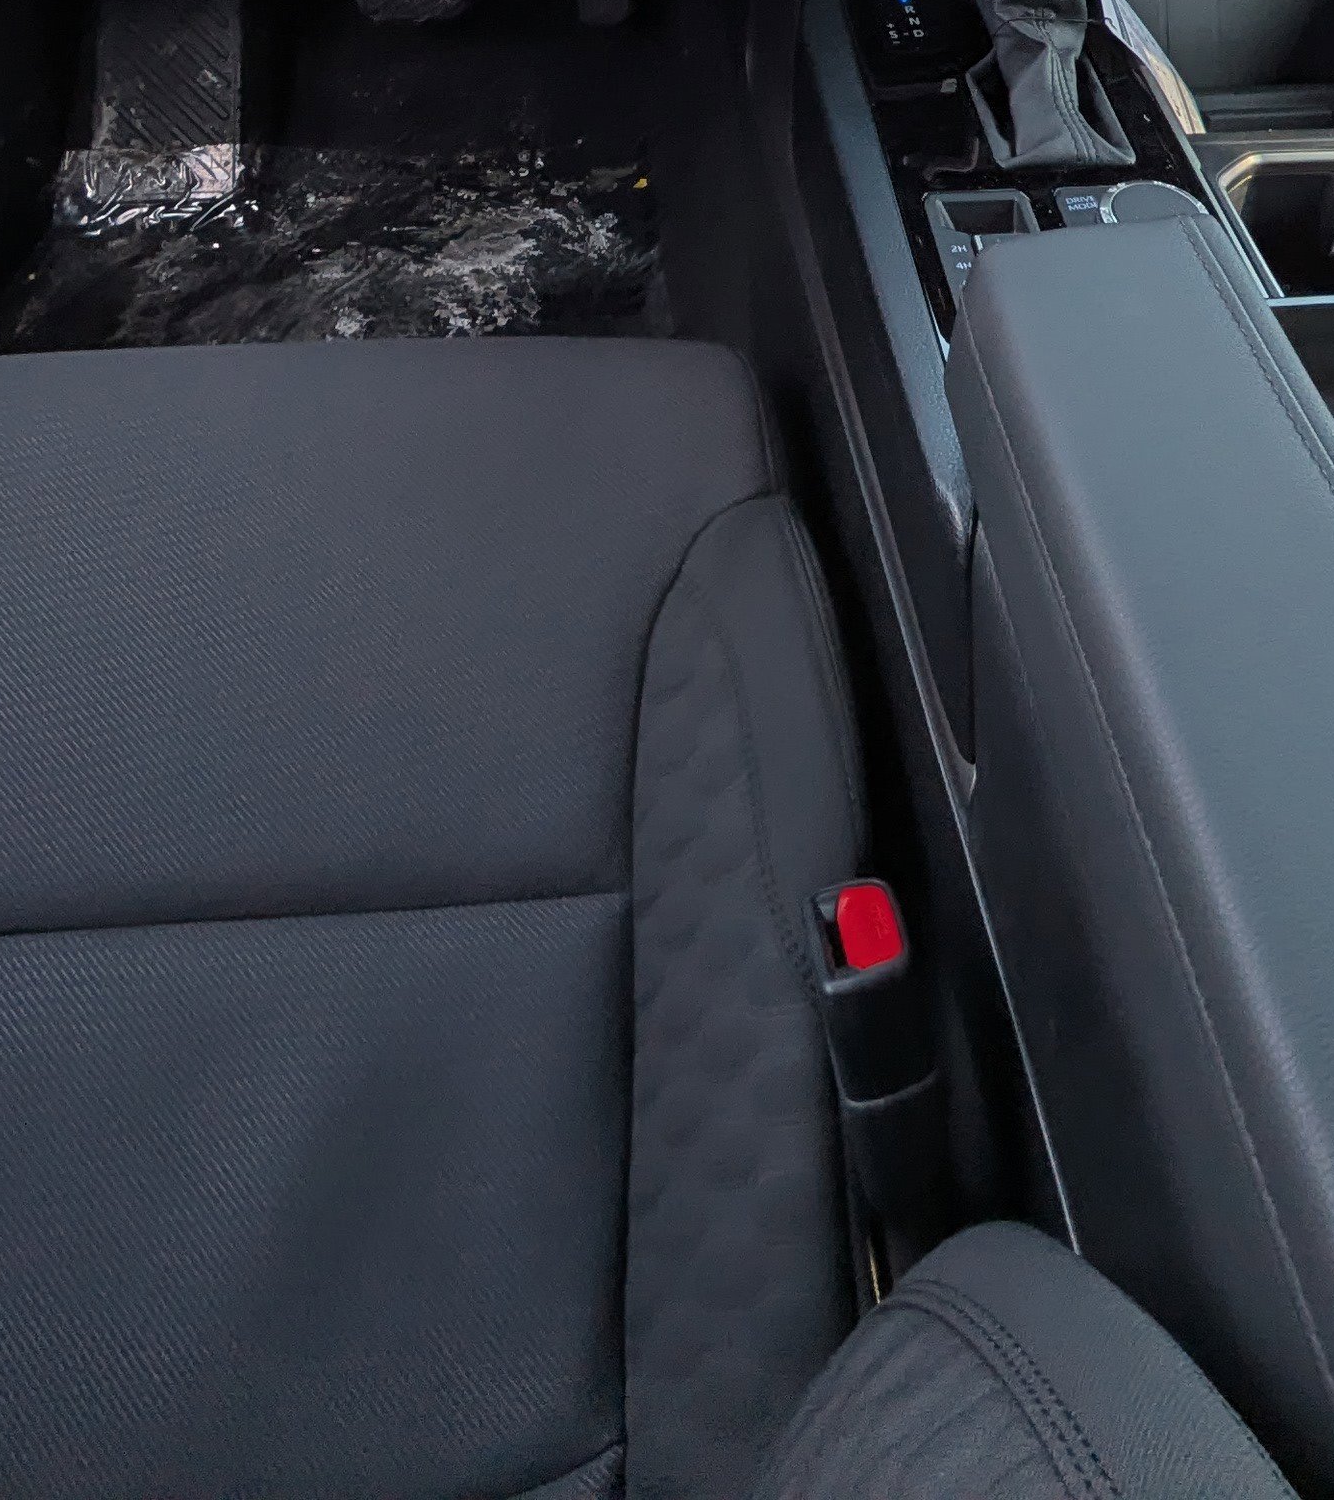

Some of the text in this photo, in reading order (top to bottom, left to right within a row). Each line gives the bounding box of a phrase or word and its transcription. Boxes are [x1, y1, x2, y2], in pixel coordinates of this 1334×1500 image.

[904, 5, 916, 14] R
[909, 17, 920, 25] N
[889, 30, 899, 39] S
[913, 29, 924, 38] D
[951, 244, 968, 253] 2H
[955, 262, 972, 270] 4H
